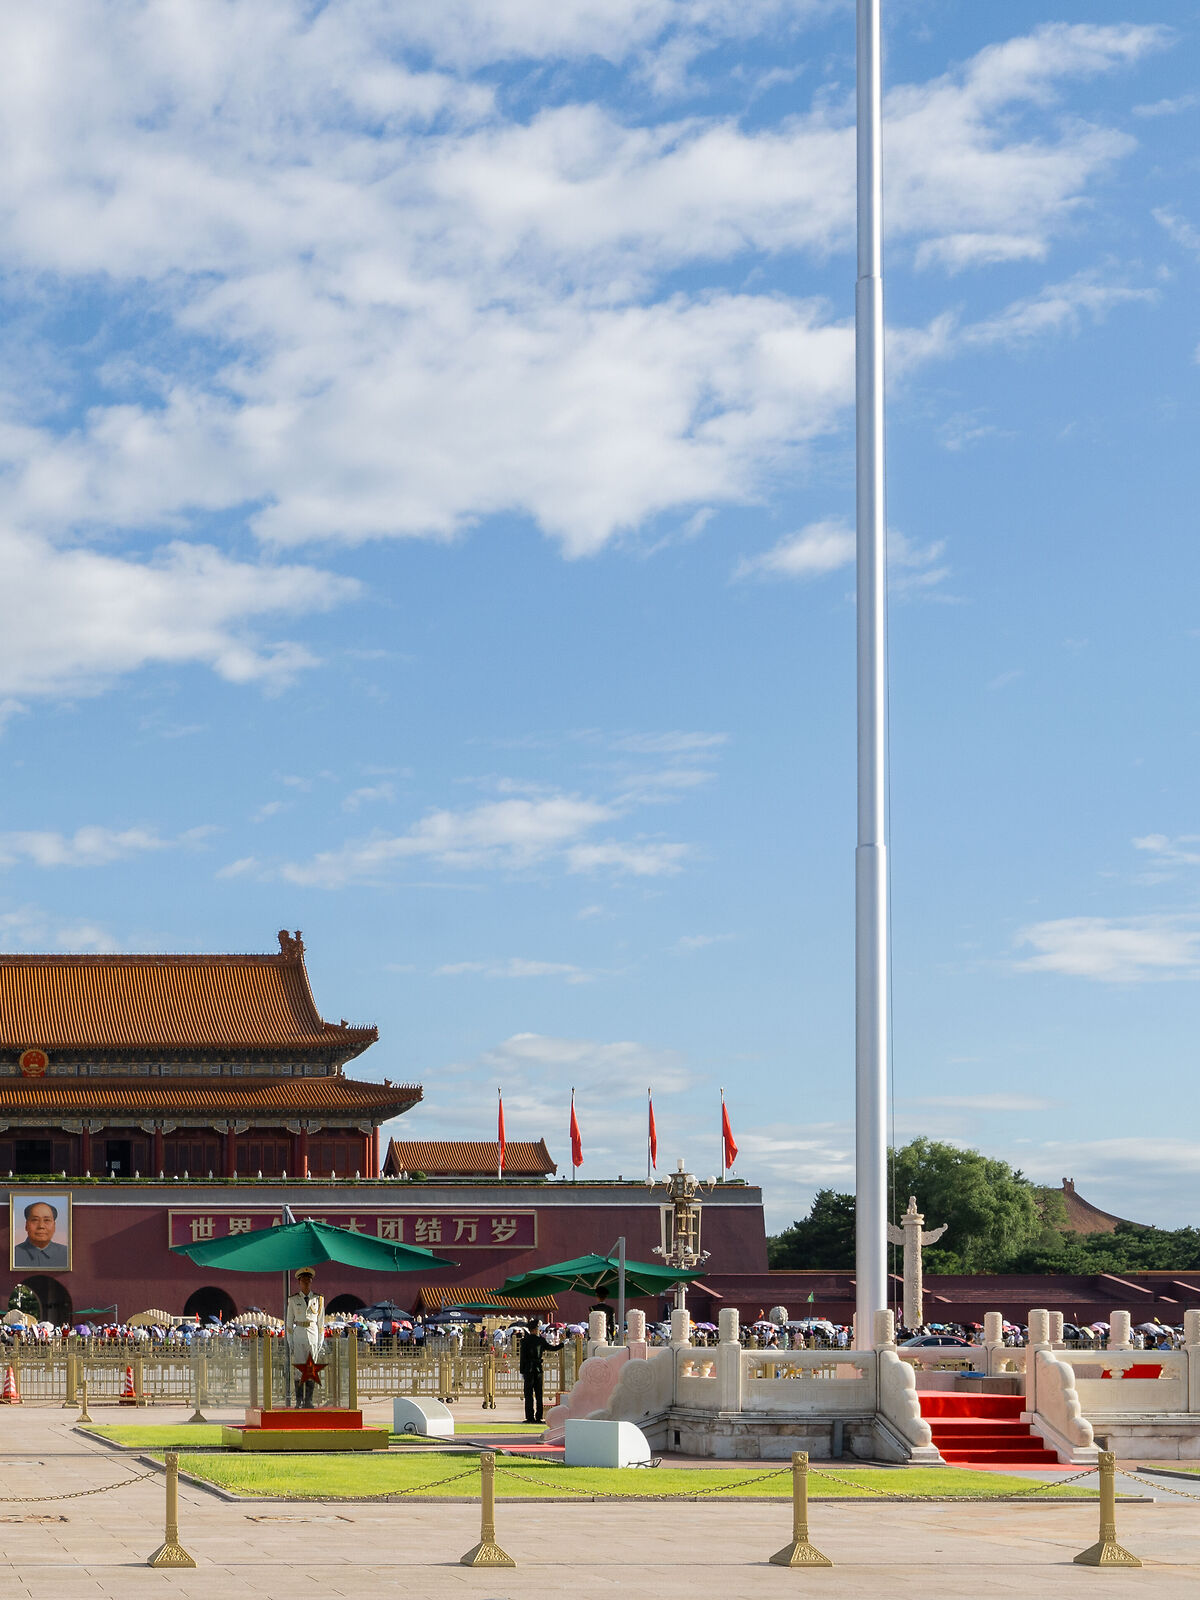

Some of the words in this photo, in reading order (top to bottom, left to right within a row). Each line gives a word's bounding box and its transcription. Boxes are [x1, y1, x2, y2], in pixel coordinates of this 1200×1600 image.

[189, 1216, 517, 1242] 世界大团结万岁
